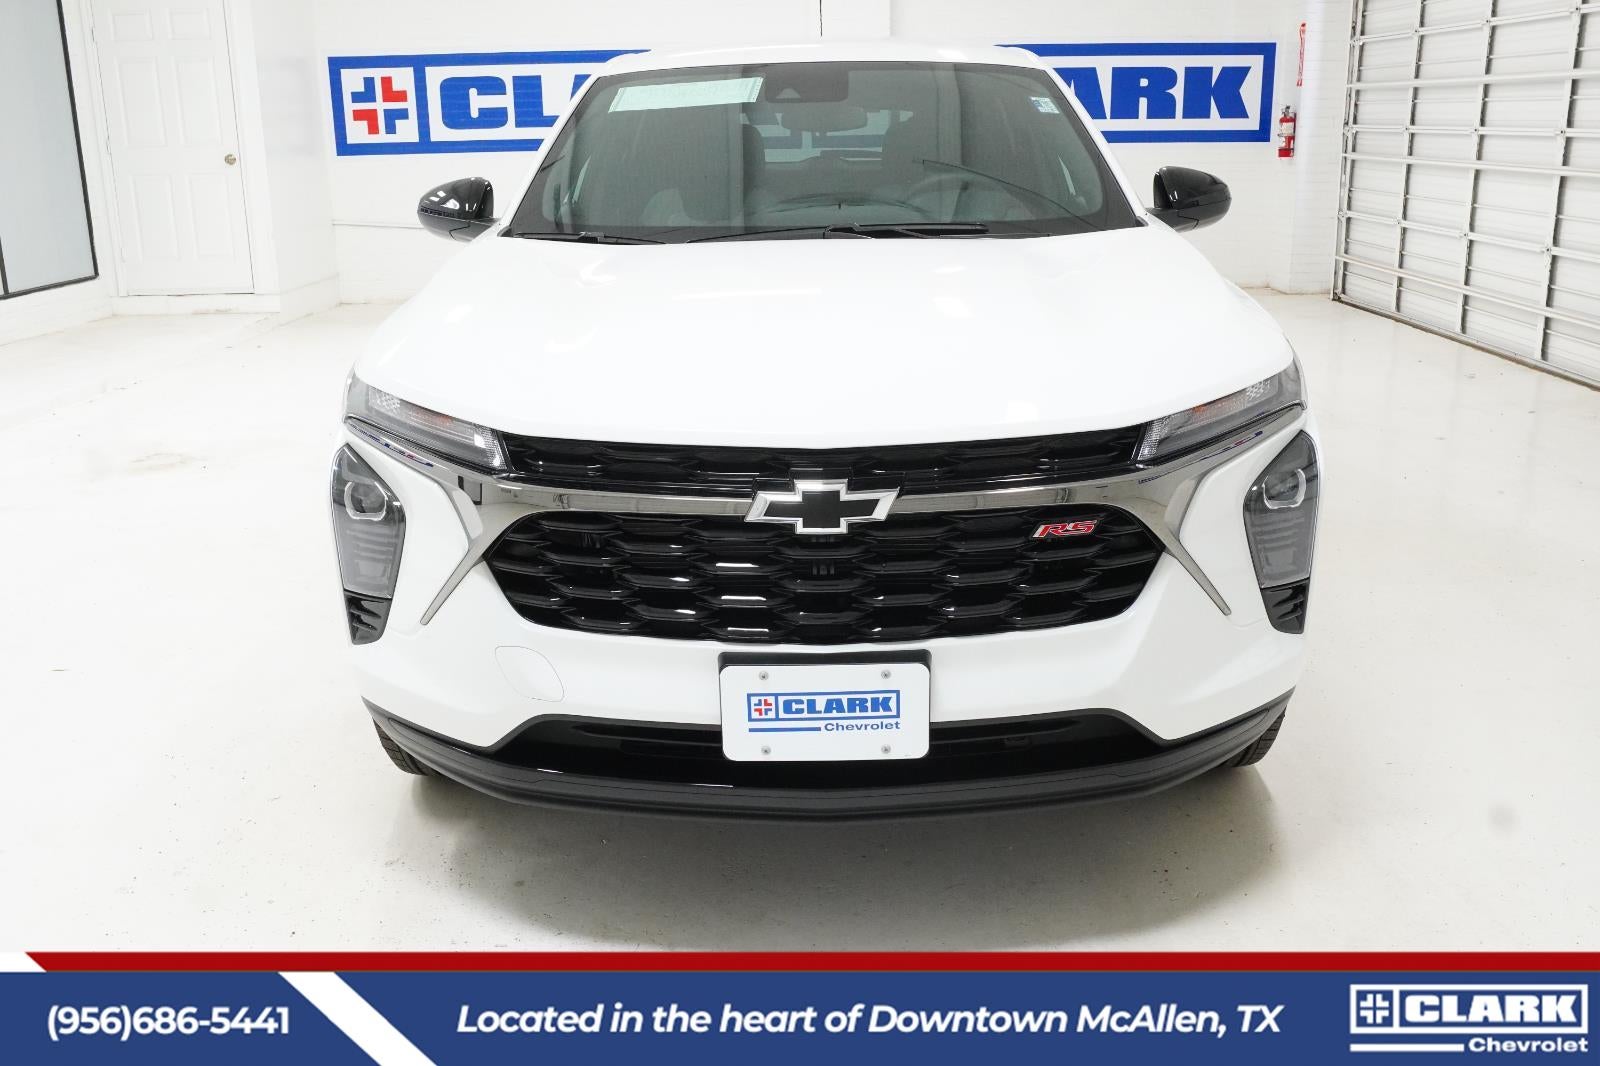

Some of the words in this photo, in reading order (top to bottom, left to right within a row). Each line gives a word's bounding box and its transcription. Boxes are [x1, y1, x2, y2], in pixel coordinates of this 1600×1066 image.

[439, 74, 592, 129] CL
[1032, 519, 1098, 538] RS
[782, 696, 893, 715] CLARK
[824, 721, 901, 732] Chevrolet
